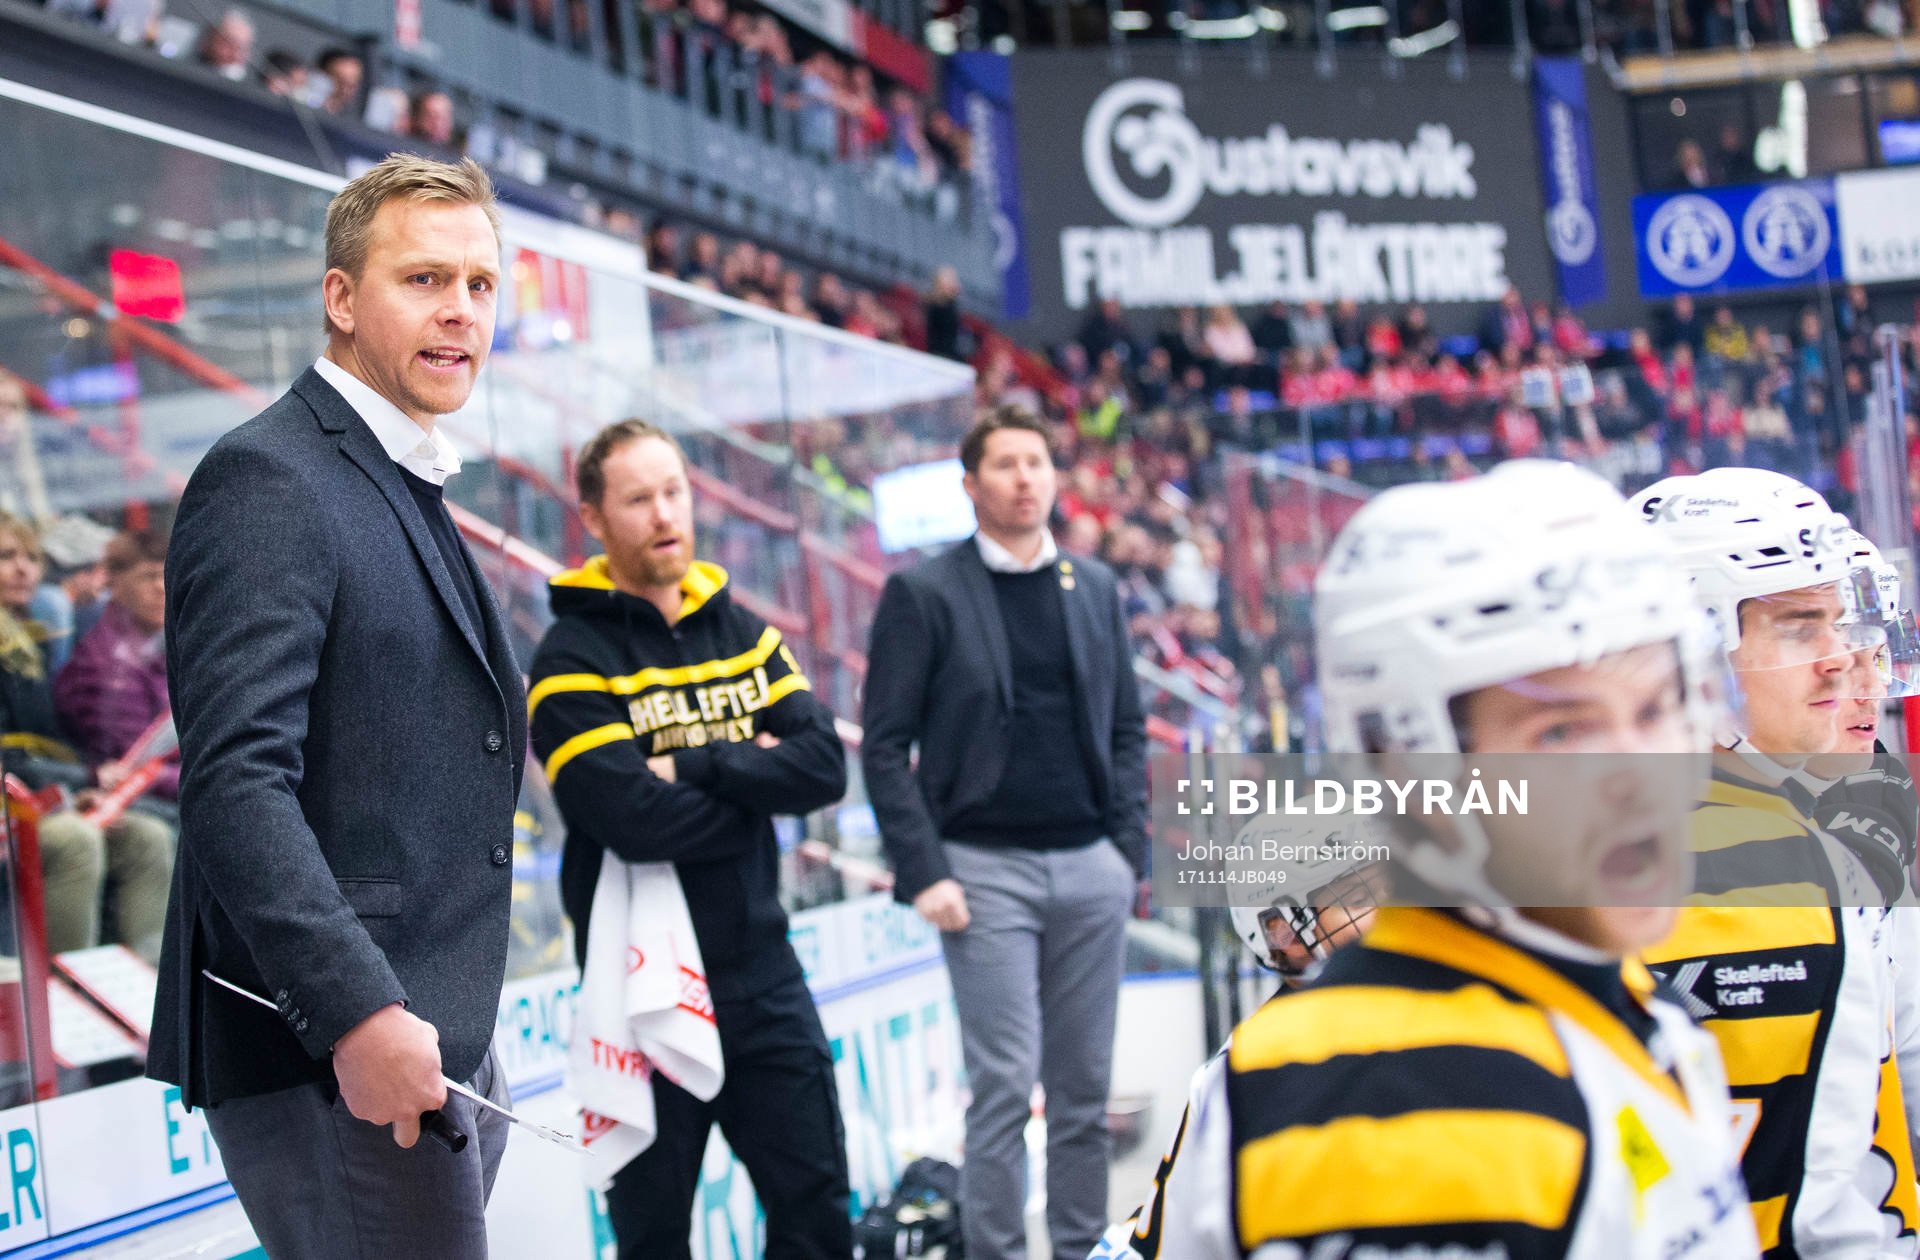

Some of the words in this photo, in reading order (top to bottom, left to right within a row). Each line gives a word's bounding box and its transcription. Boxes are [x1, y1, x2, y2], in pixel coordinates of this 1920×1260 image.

[1083, 78, 1476, 228] Gustavsvik
[1714, 960, 1807, 985] Skellefteå
[1716, 986, 1764, 1006] Kraft
